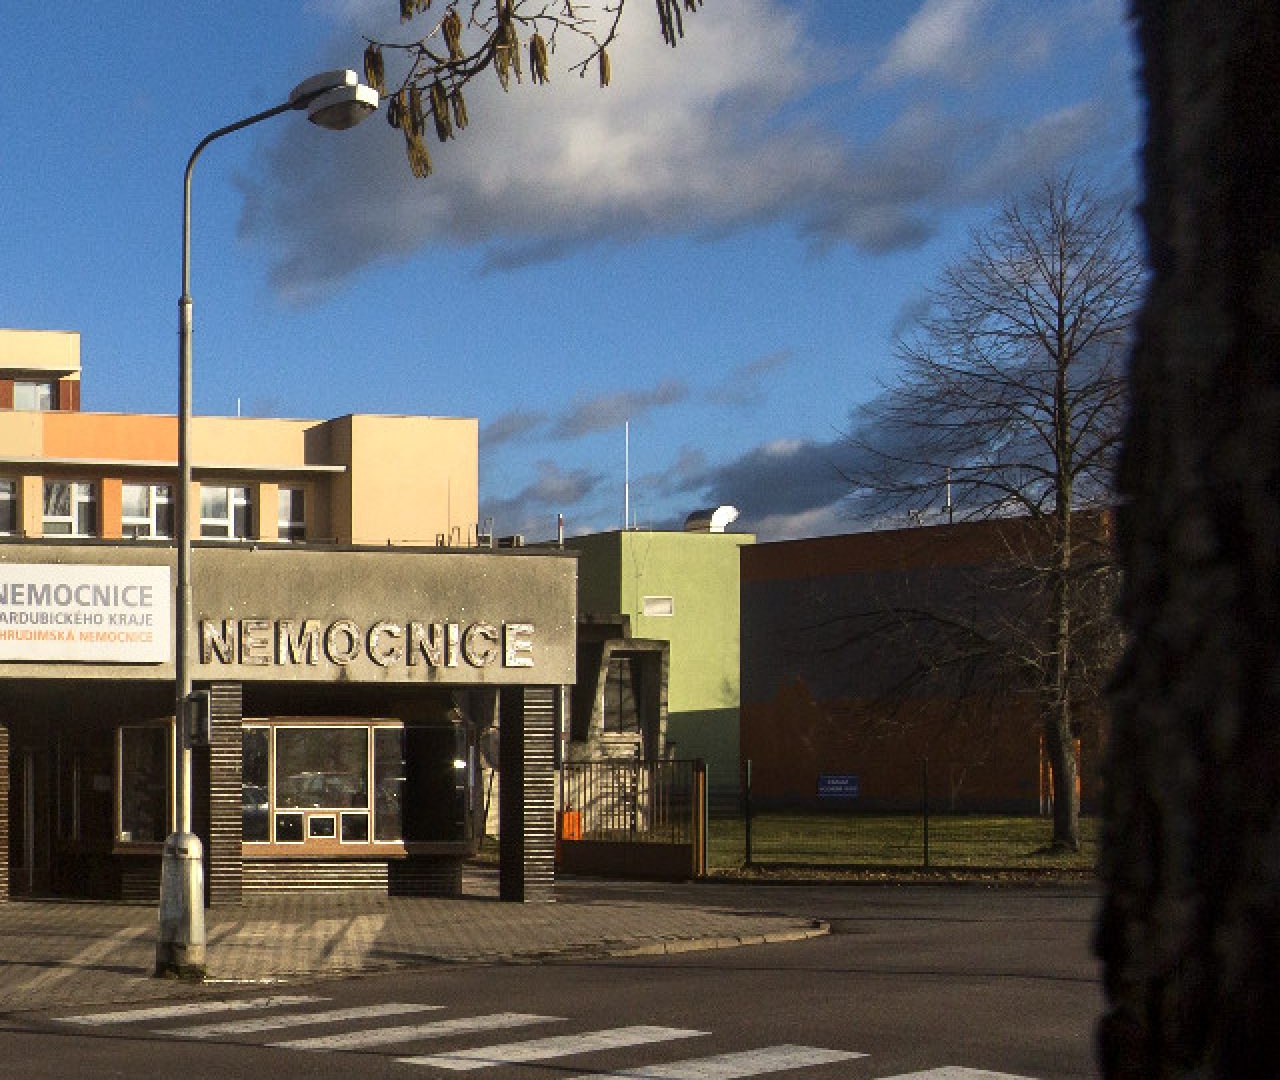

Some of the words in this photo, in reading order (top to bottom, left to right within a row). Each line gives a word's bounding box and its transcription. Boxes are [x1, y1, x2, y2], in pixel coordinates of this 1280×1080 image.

[109, 613, 153, 627] KRAJE
[79, 631, 153, 643] NEMOCNICE
[197, 619, 536, 669] NEMOCNICE
